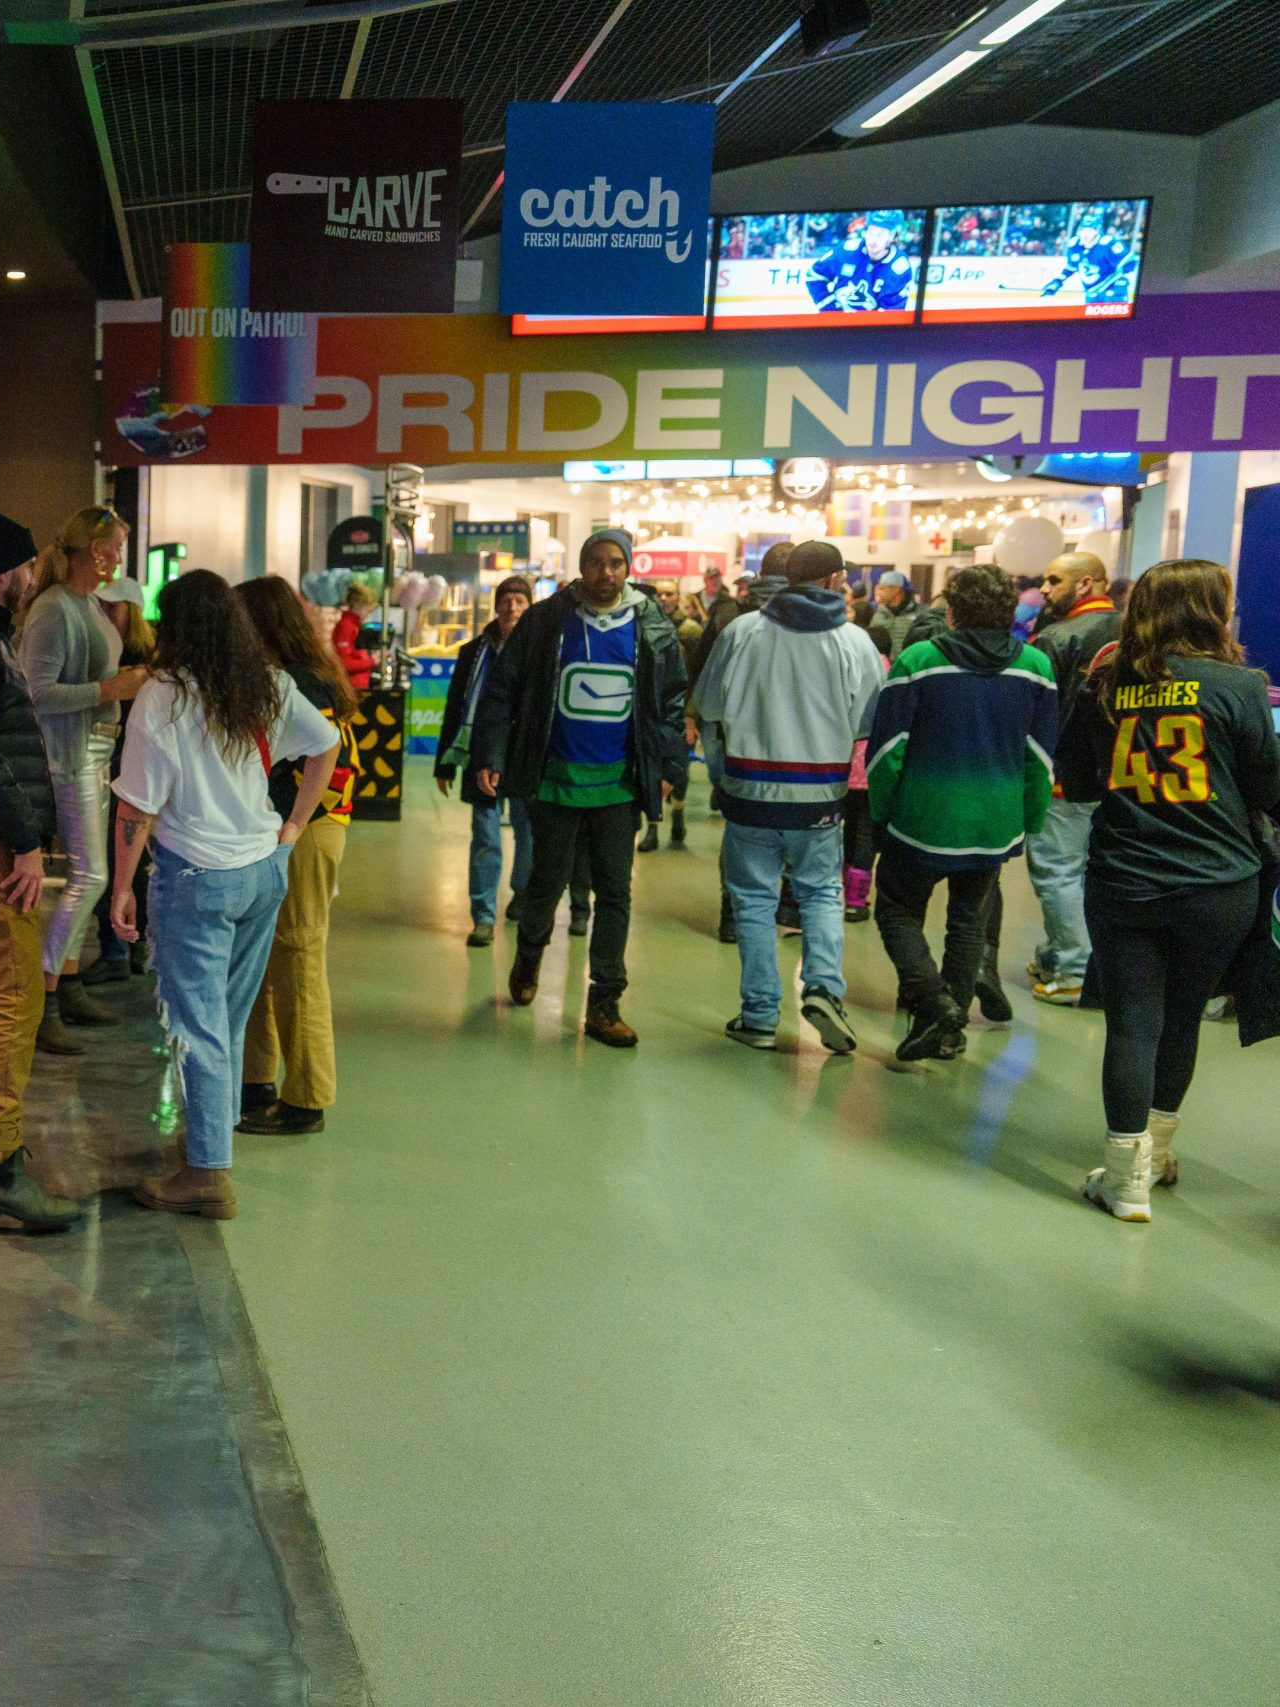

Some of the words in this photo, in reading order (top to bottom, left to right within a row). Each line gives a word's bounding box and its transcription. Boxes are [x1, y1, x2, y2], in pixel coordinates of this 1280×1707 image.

[327, 169, 447, 228] CARVE
[520, 176, 682, 234] catch
[325, 224, 348, 238] HAND
[350, 228, 383, 242] CARVED
[384, 230, 441, 243] SANDWICHES
[523, 232, 560, 247] FRESH
[562, 233, 609, 248] CAUGHT
[611, 233, 663, 248] SEAFOOD
[170, 307, 208, 338] OUT
[211, 307, 237, 338] ON
[1085, 303, 1130, 317] ROGERS
[277, 368, 724, 455] PRIDE
[763, 353, 1280, 448] NIGHT
[1115, 680, 1200, 710] HUGHES
[1108, 713, 1210, 804] 43
